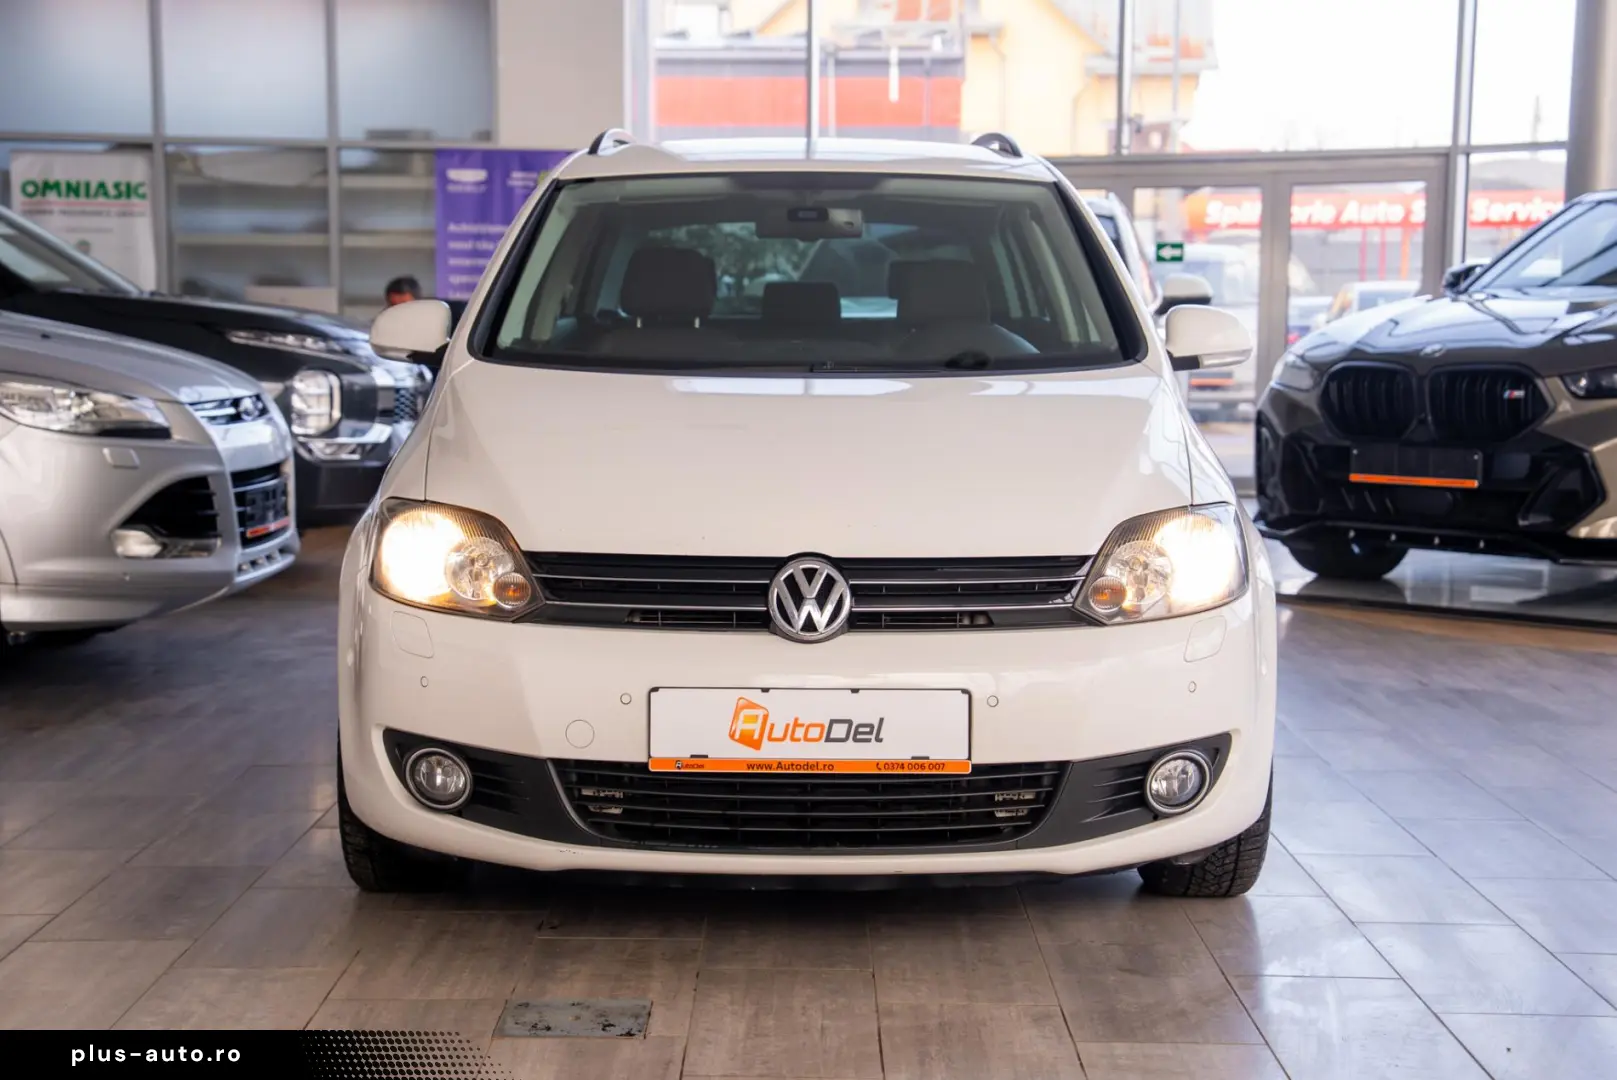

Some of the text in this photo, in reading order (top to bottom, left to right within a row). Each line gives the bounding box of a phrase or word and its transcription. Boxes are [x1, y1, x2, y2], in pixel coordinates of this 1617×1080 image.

[732, 704, 885, 745] AutoDel
[746, 761, 835, 772] www.Autodel.ro
[883, 762, 946, 771] 0374 006 007
